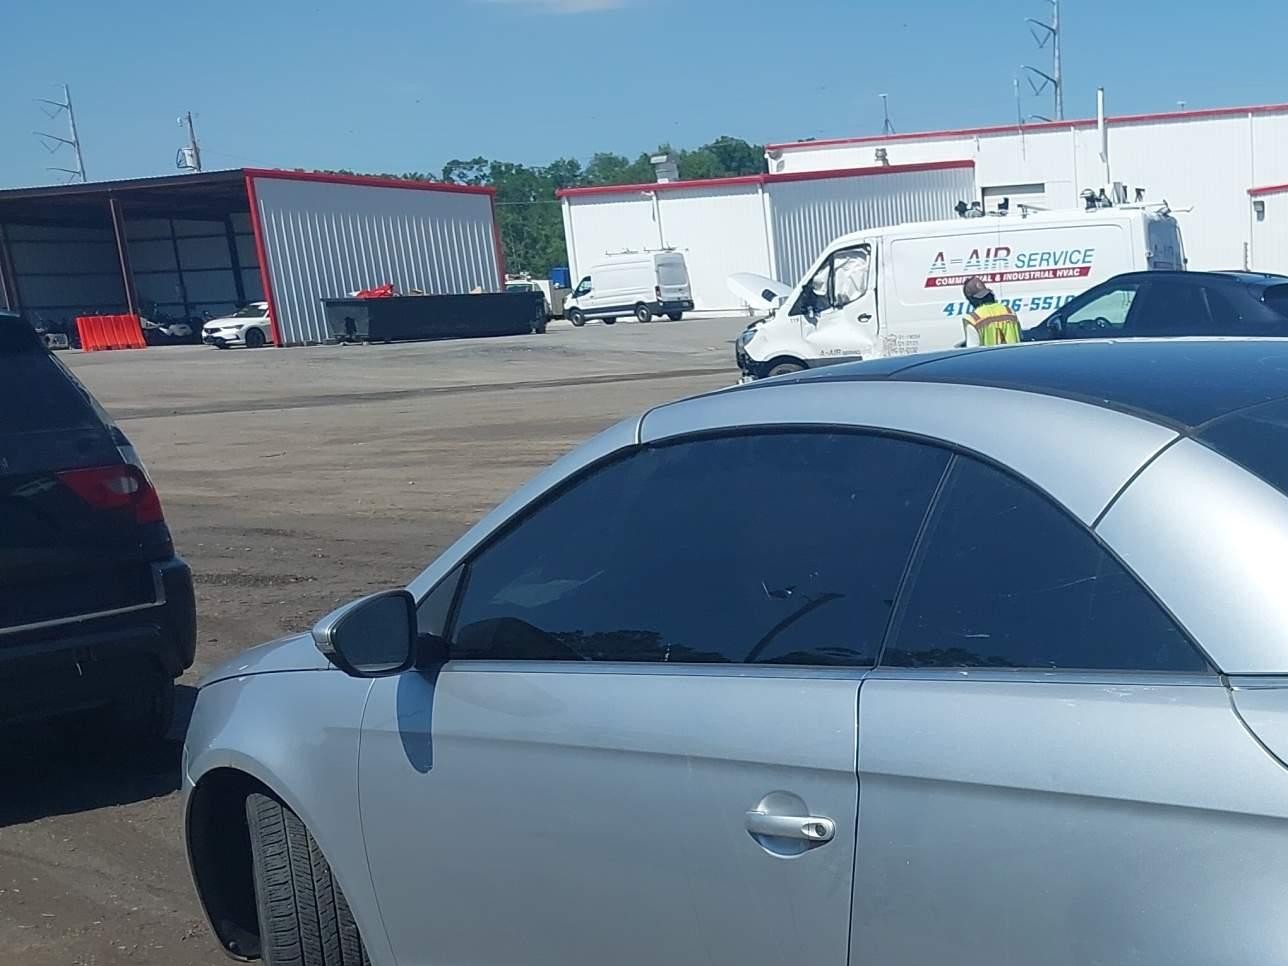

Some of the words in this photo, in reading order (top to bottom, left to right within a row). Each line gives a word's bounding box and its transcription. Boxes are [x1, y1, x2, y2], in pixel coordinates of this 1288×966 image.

[928, 246, 1011, 274] A-AIR
[1014, 248, 1095, 269] SERVICE
[994, 273, 1001, 282] &
[1003, 270, 1054, 281] INDUSTRIAL
[1056, 268, 1081, 277] HVAC
